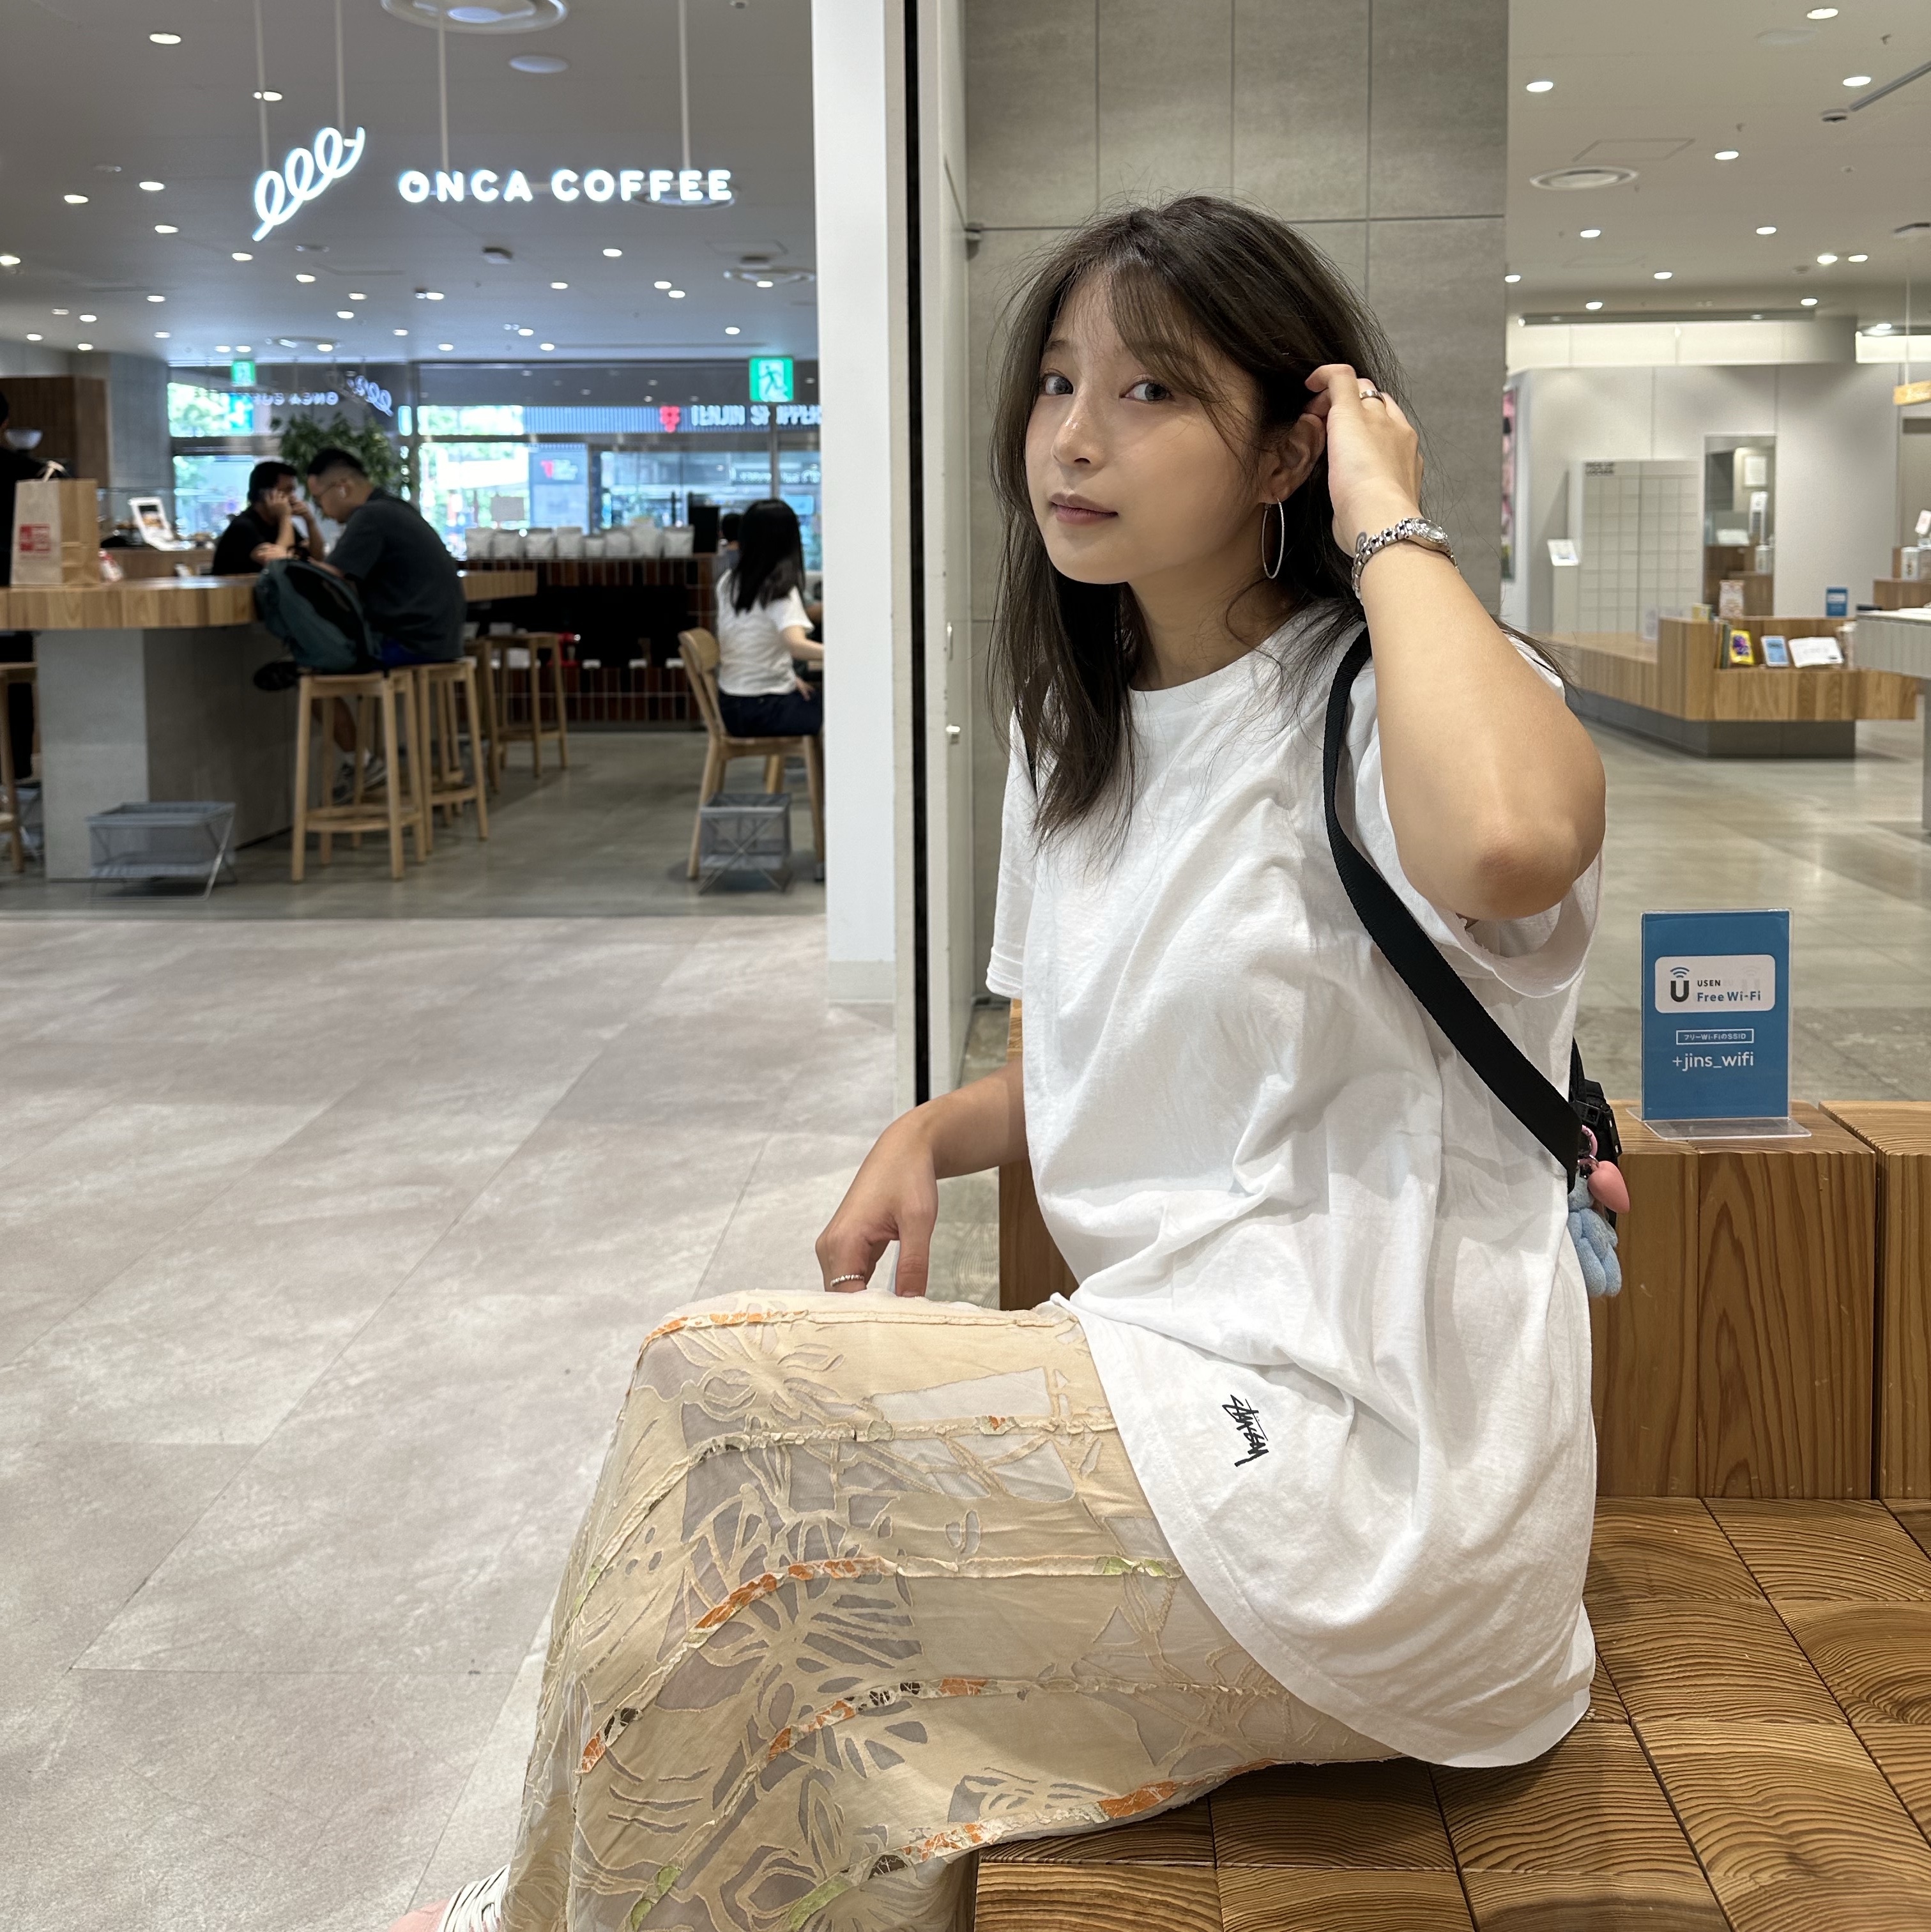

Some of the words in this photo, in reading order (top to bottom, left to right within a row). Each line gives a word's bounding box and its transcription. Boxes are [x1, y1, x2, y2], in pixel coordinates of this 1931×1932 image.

[398, 169, 533, 203] ONCA
[551, 169, 733, 202] COFFEE
[1697, 992, 1725, 1002] Free
[1727, 990, 1761, 1002] Wi-Fi
[1672, 1051, 1754, 1072] +jins_wifi
